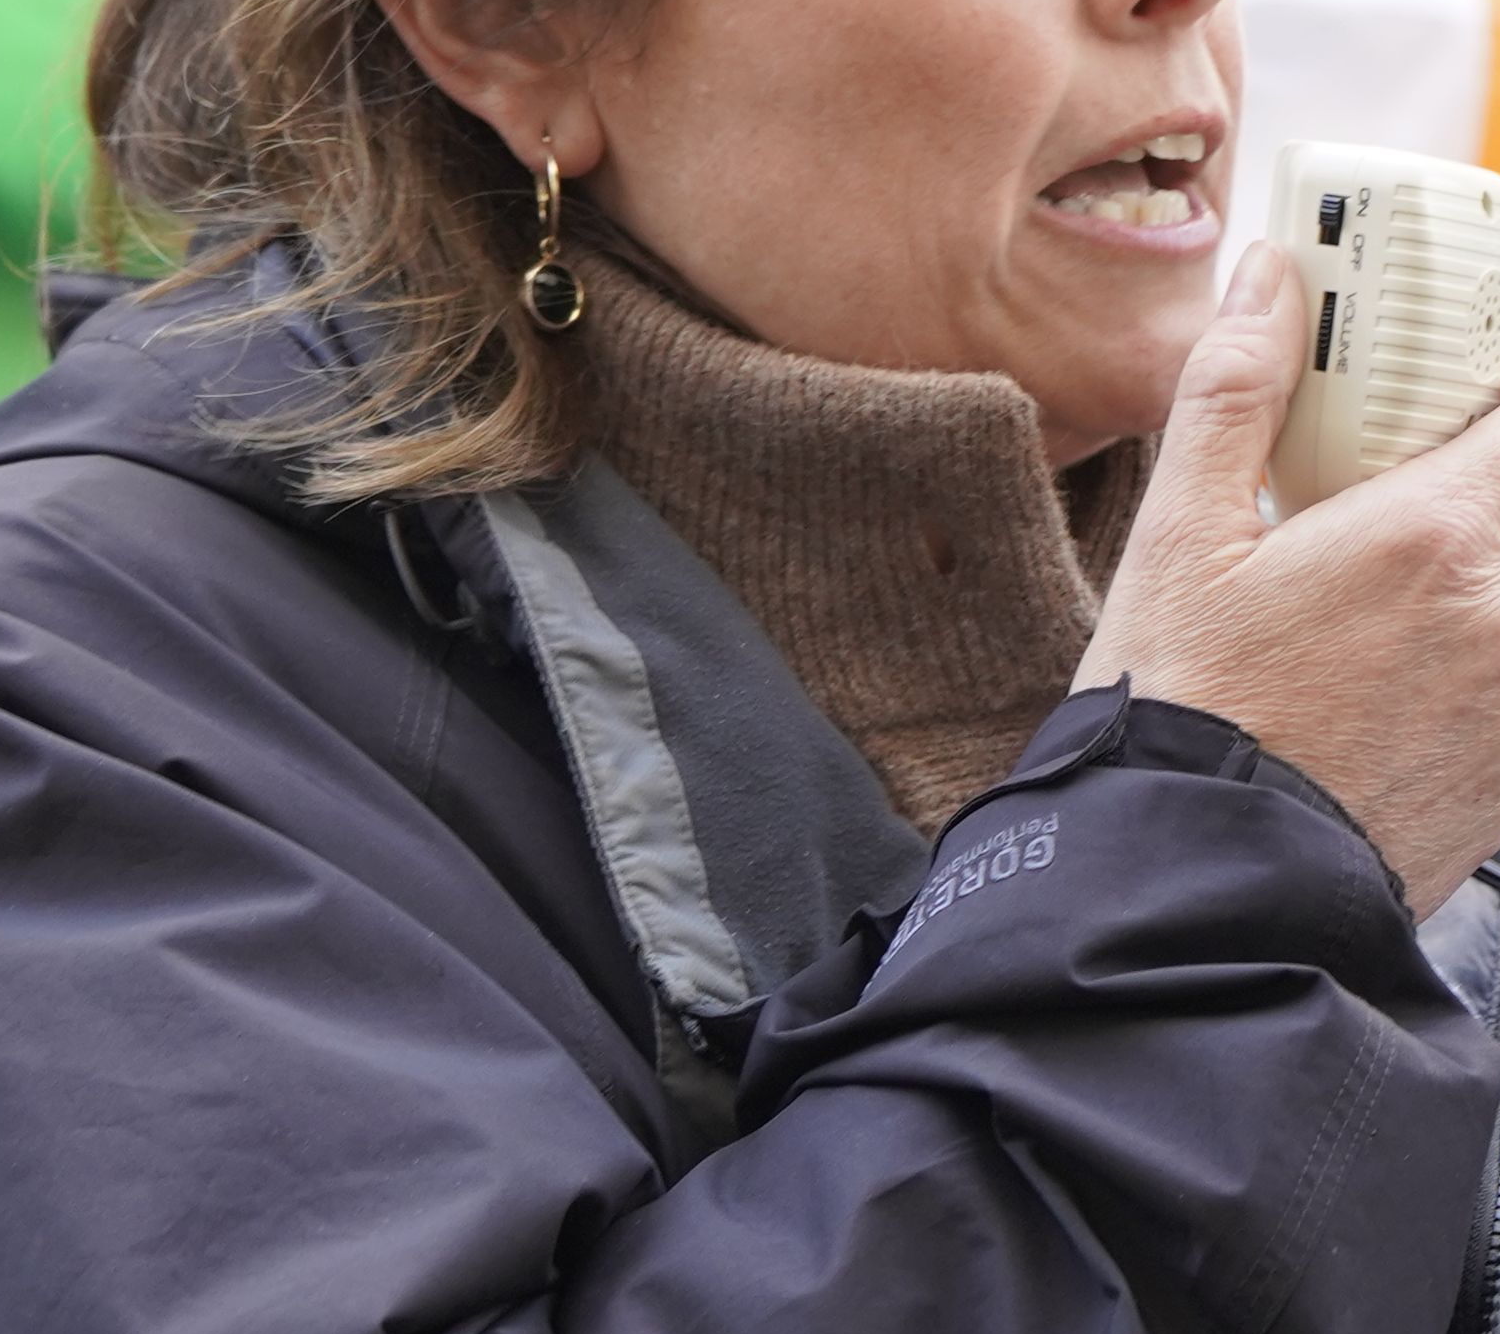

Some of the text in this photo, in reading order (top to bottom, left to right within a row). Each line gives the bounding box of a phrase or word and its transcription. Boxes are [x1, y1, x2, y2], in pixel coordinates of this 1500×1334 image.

[1351, 187, 1371, 271] ON OFF
[1334, 291, 1358, 375] VOLUME
